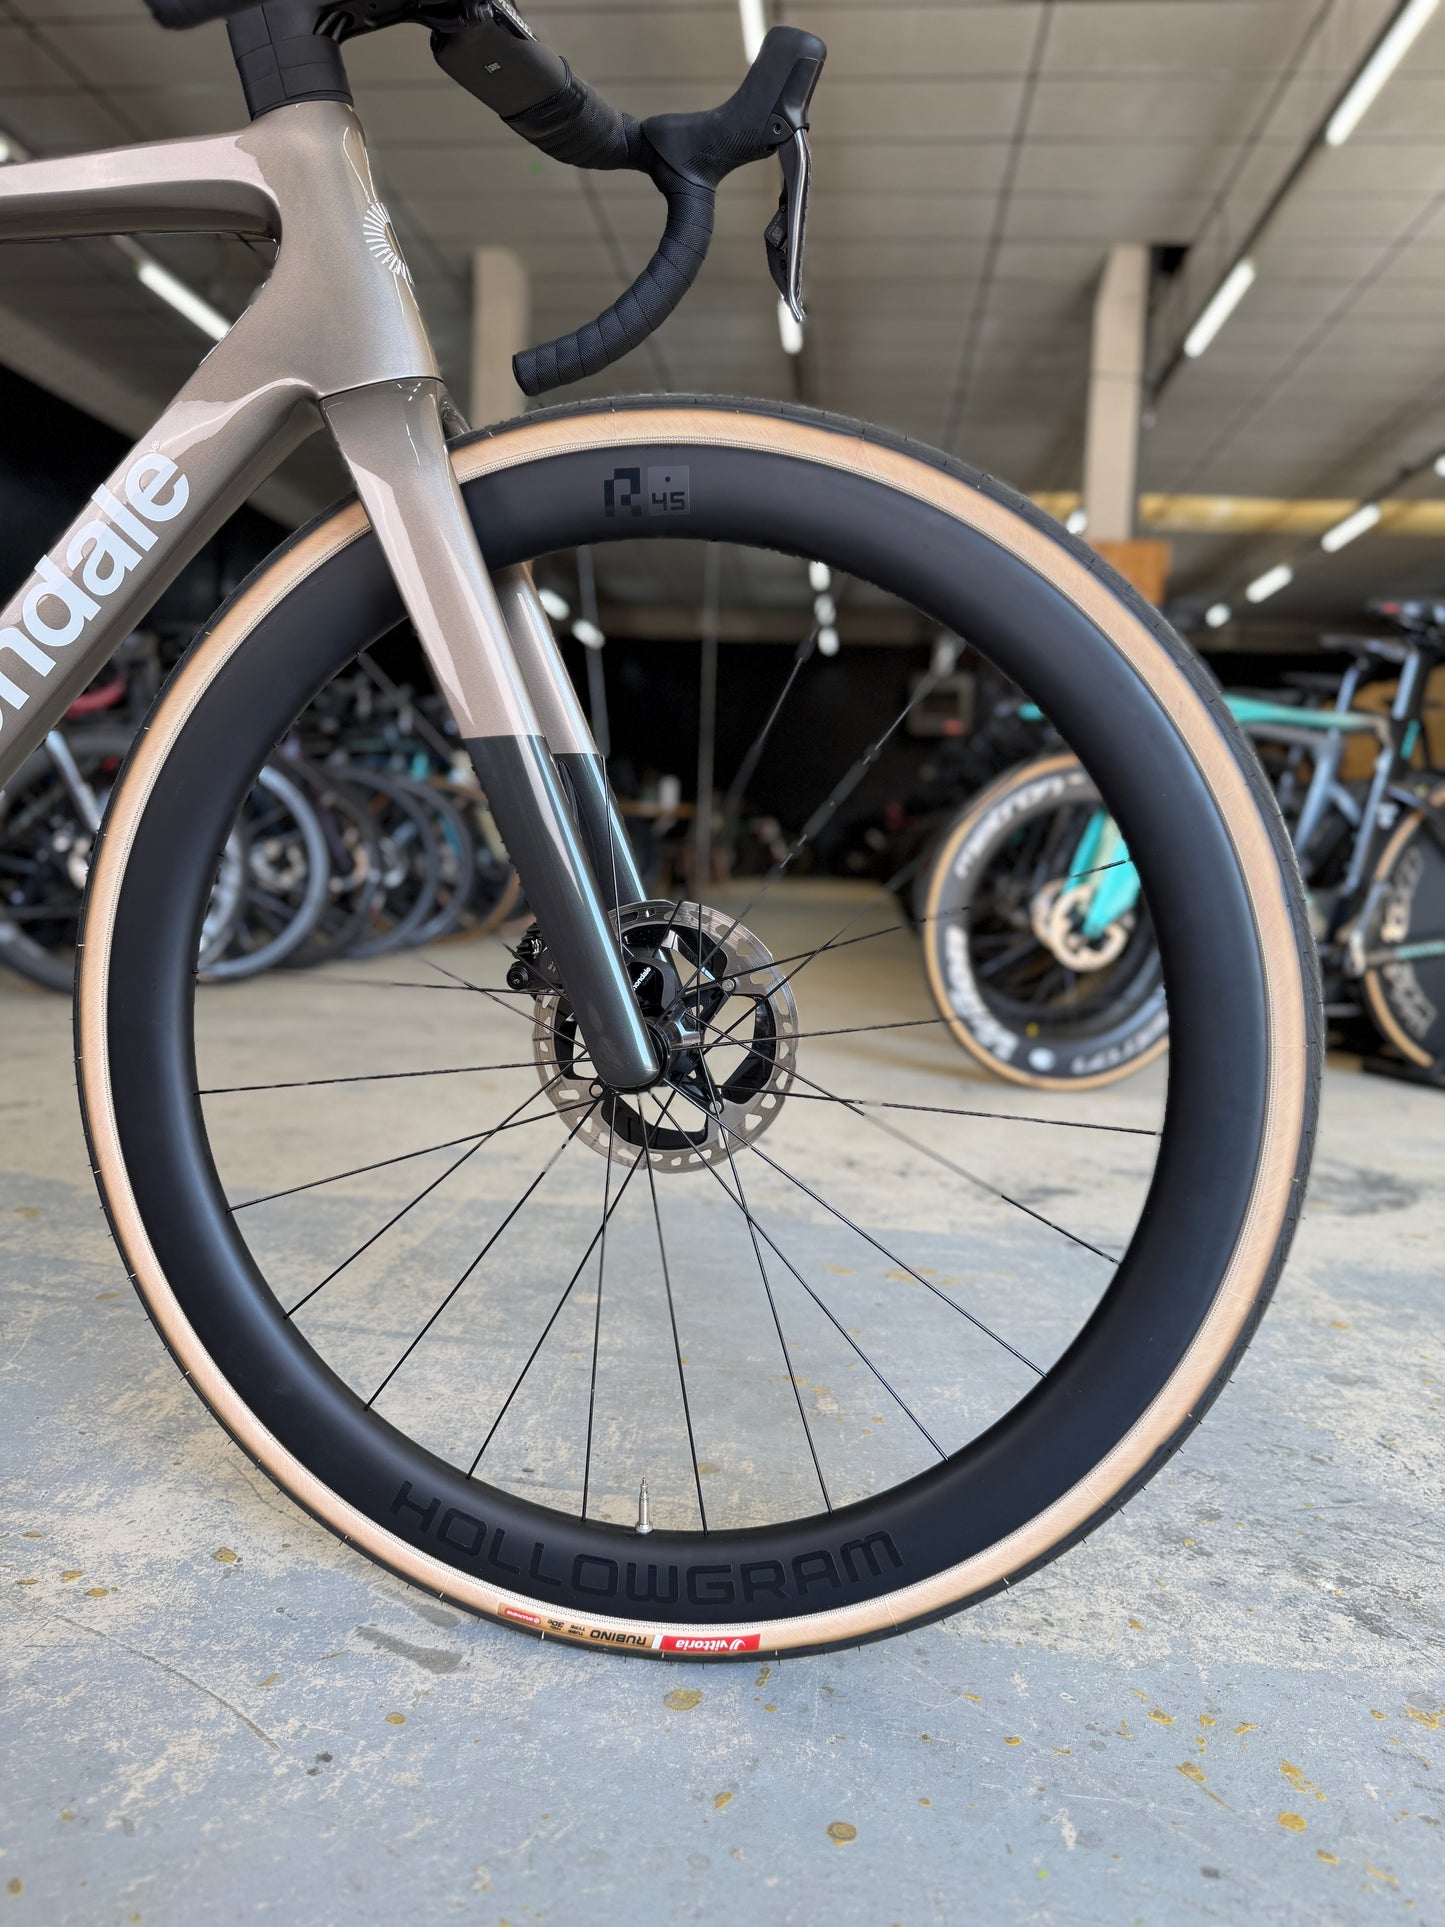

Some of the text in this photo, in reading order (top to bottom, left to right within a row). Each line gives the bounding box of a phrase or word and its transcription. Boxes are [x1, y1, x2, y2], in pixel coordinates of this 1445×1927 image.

[652, 491, 686, 511] 45
[0, 453, 190, 733] ndale
[390, 1480, 904, 1606] HOLLOWGRAM
[589, 1629, 647, 1646] RUBINO
[675, 1639, 729, 1650] vittoria
